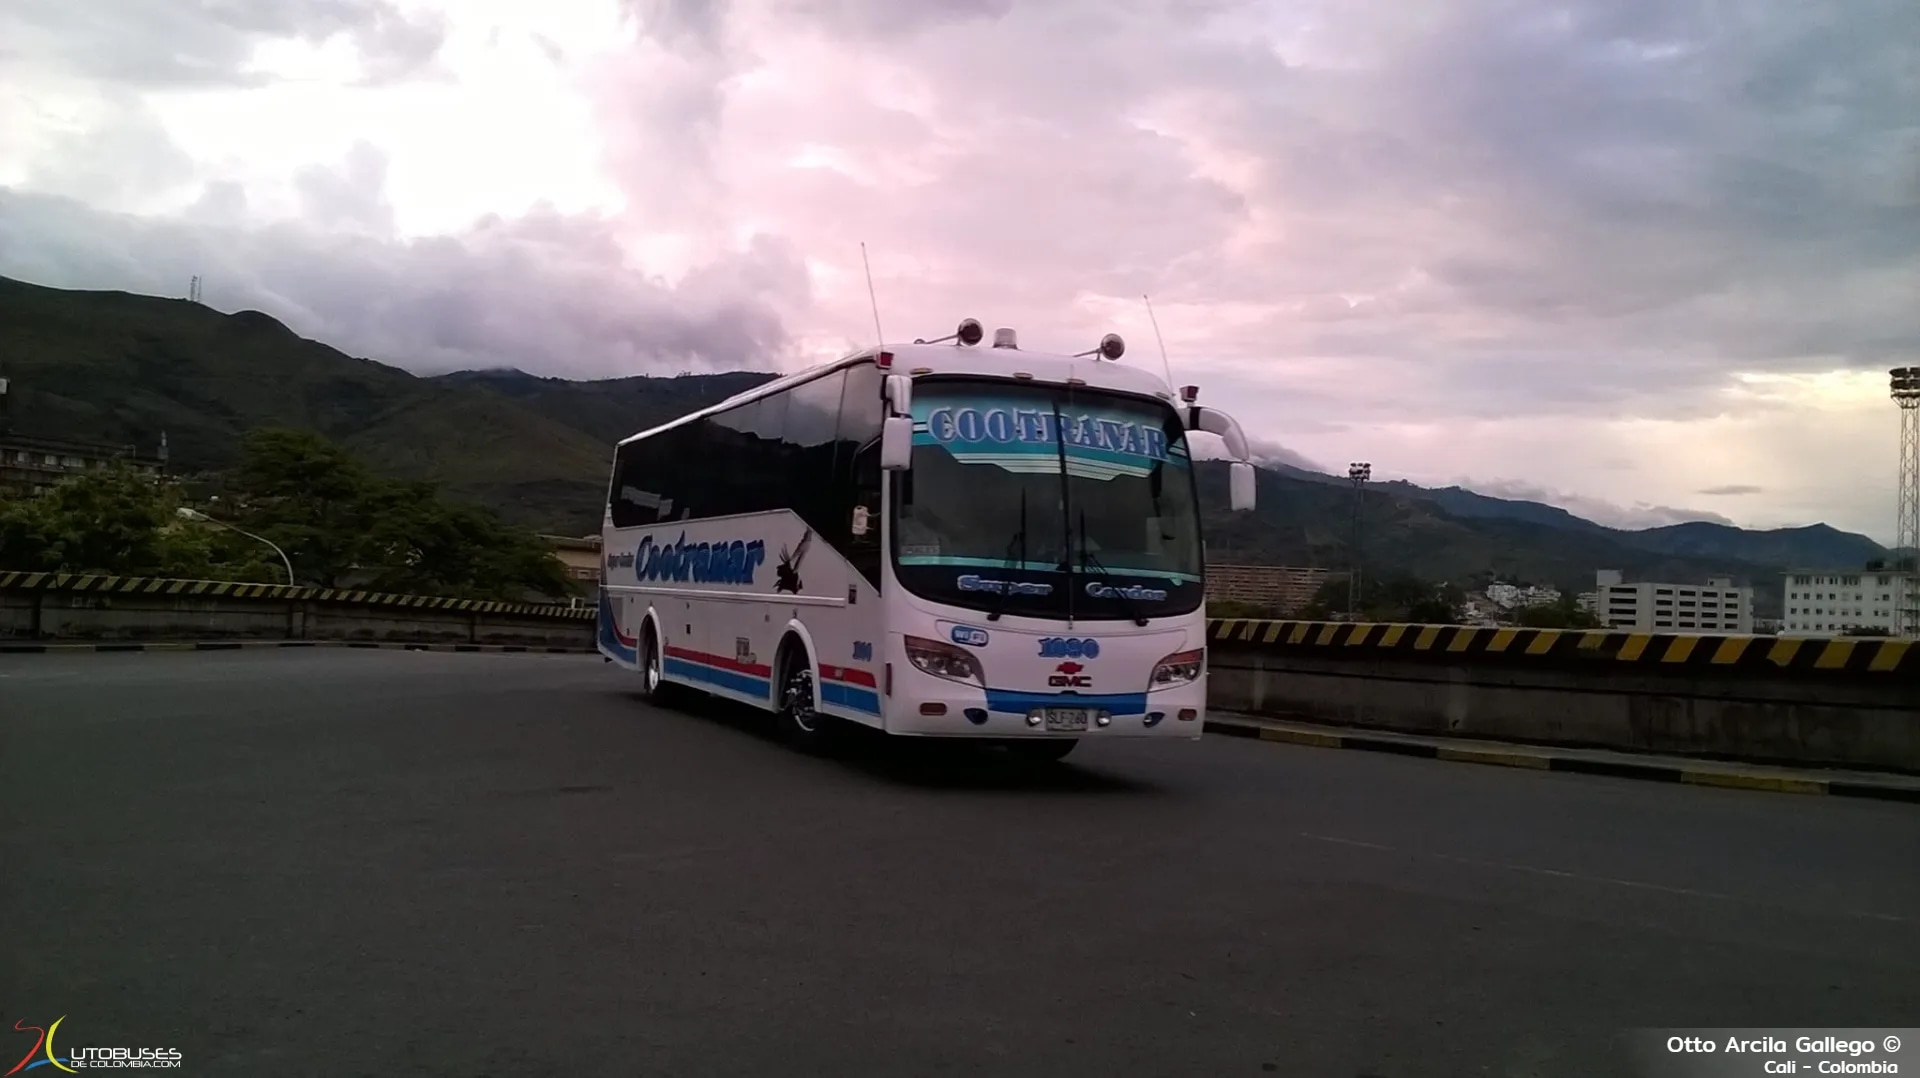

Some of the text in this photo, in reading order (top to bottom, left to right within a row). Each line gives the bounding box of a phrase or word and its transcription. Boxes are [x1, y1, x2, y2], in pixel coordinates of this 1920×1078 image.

[927, 406, 1168, 460] COOTRANAR
[635, 530, 765, 586] Cootranar
[957, 574, 1168, 601] Super Condor
[1048, 675, 1093, 687] GMC
